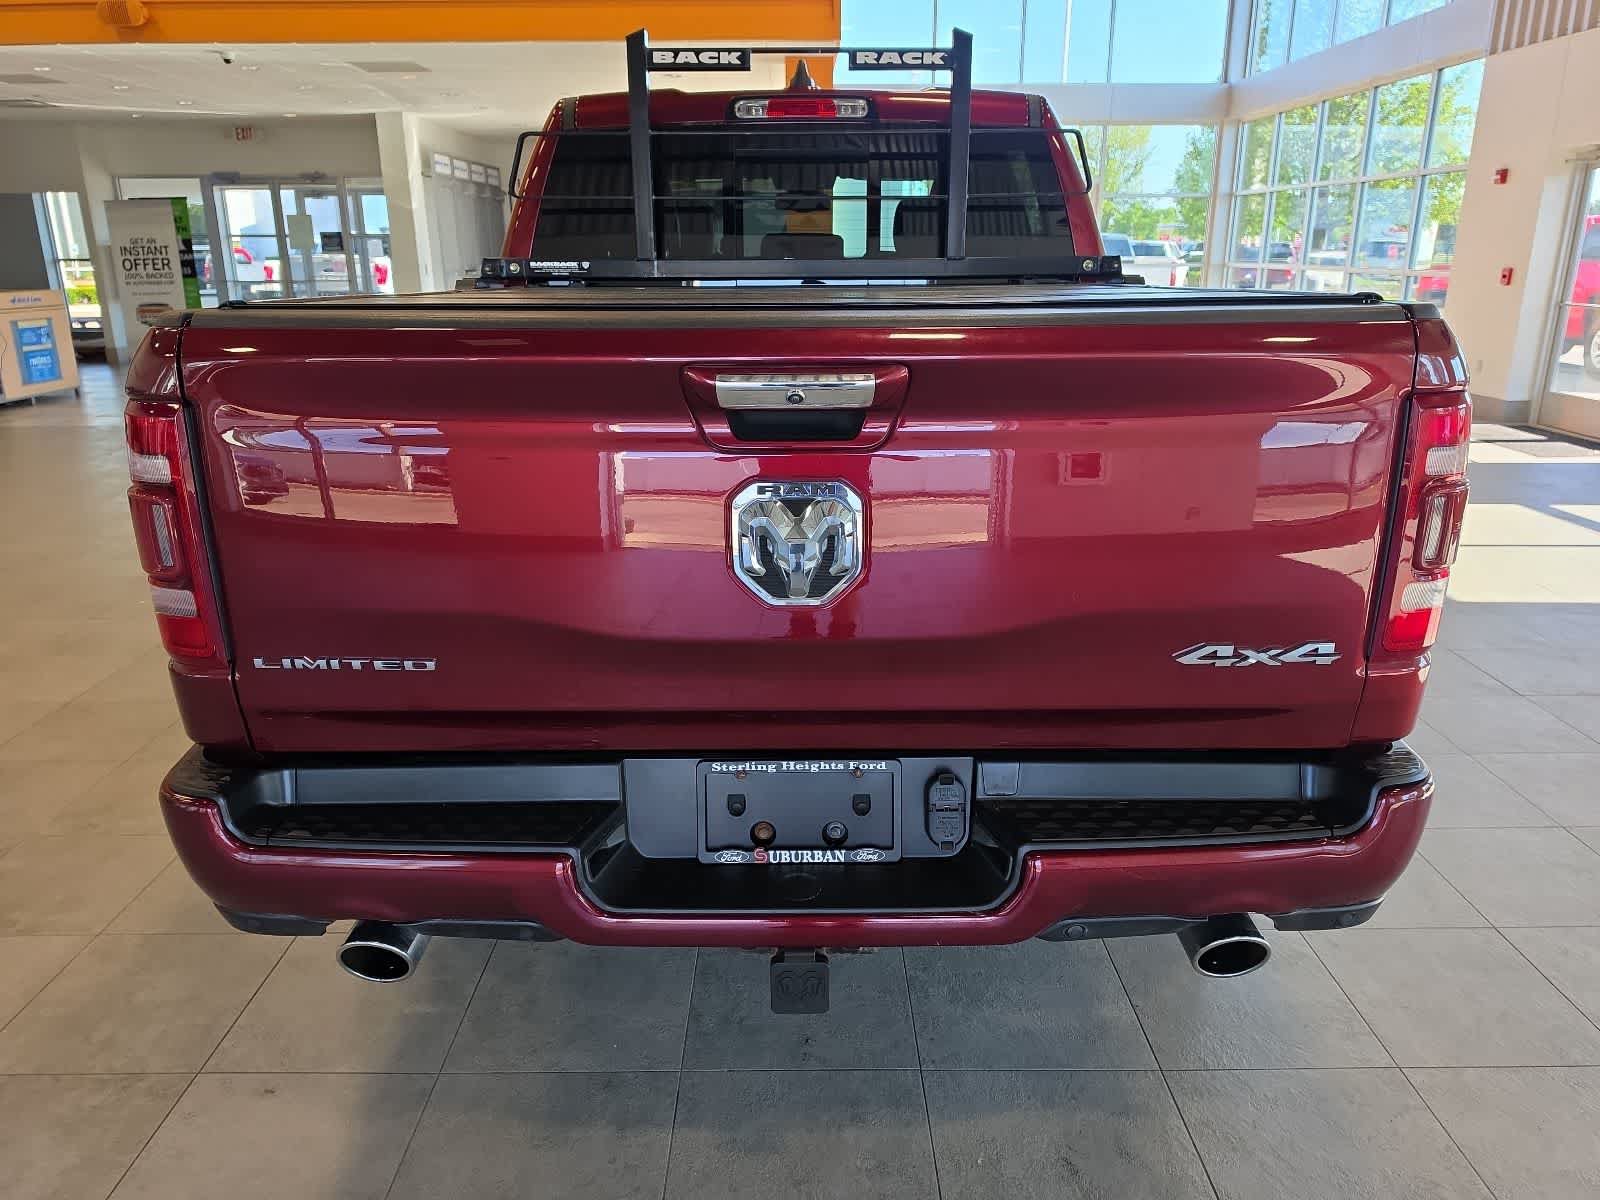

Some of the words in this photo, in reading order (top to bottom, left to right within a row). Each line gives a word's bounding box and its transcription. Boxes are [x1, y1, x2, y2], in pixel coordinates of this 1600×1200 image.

[653, 51, 742, 65] BACK
[856, 51, 946, 65] RACK
[235, 127, 253, 141] EXIT
[129, 237, 144, 245] GET
[146, 237, 157, 245] AN
[119, 245, 169, 257] INSTANT
[122, 257, 173, 272] OFFER
[146, 271, 174, 280] BACKED
[756, 483, 837, 496] RAM
[1171, 641, 1344, 667] 4x4
[252, 656, 437, 671] LIMITED
[711, 761, 777, 773] Sterling
[781, 760, 845, 772] Heights
[848, 760, 888, 771] Ford
[753, 847, 846, 864] SUBURBAN
